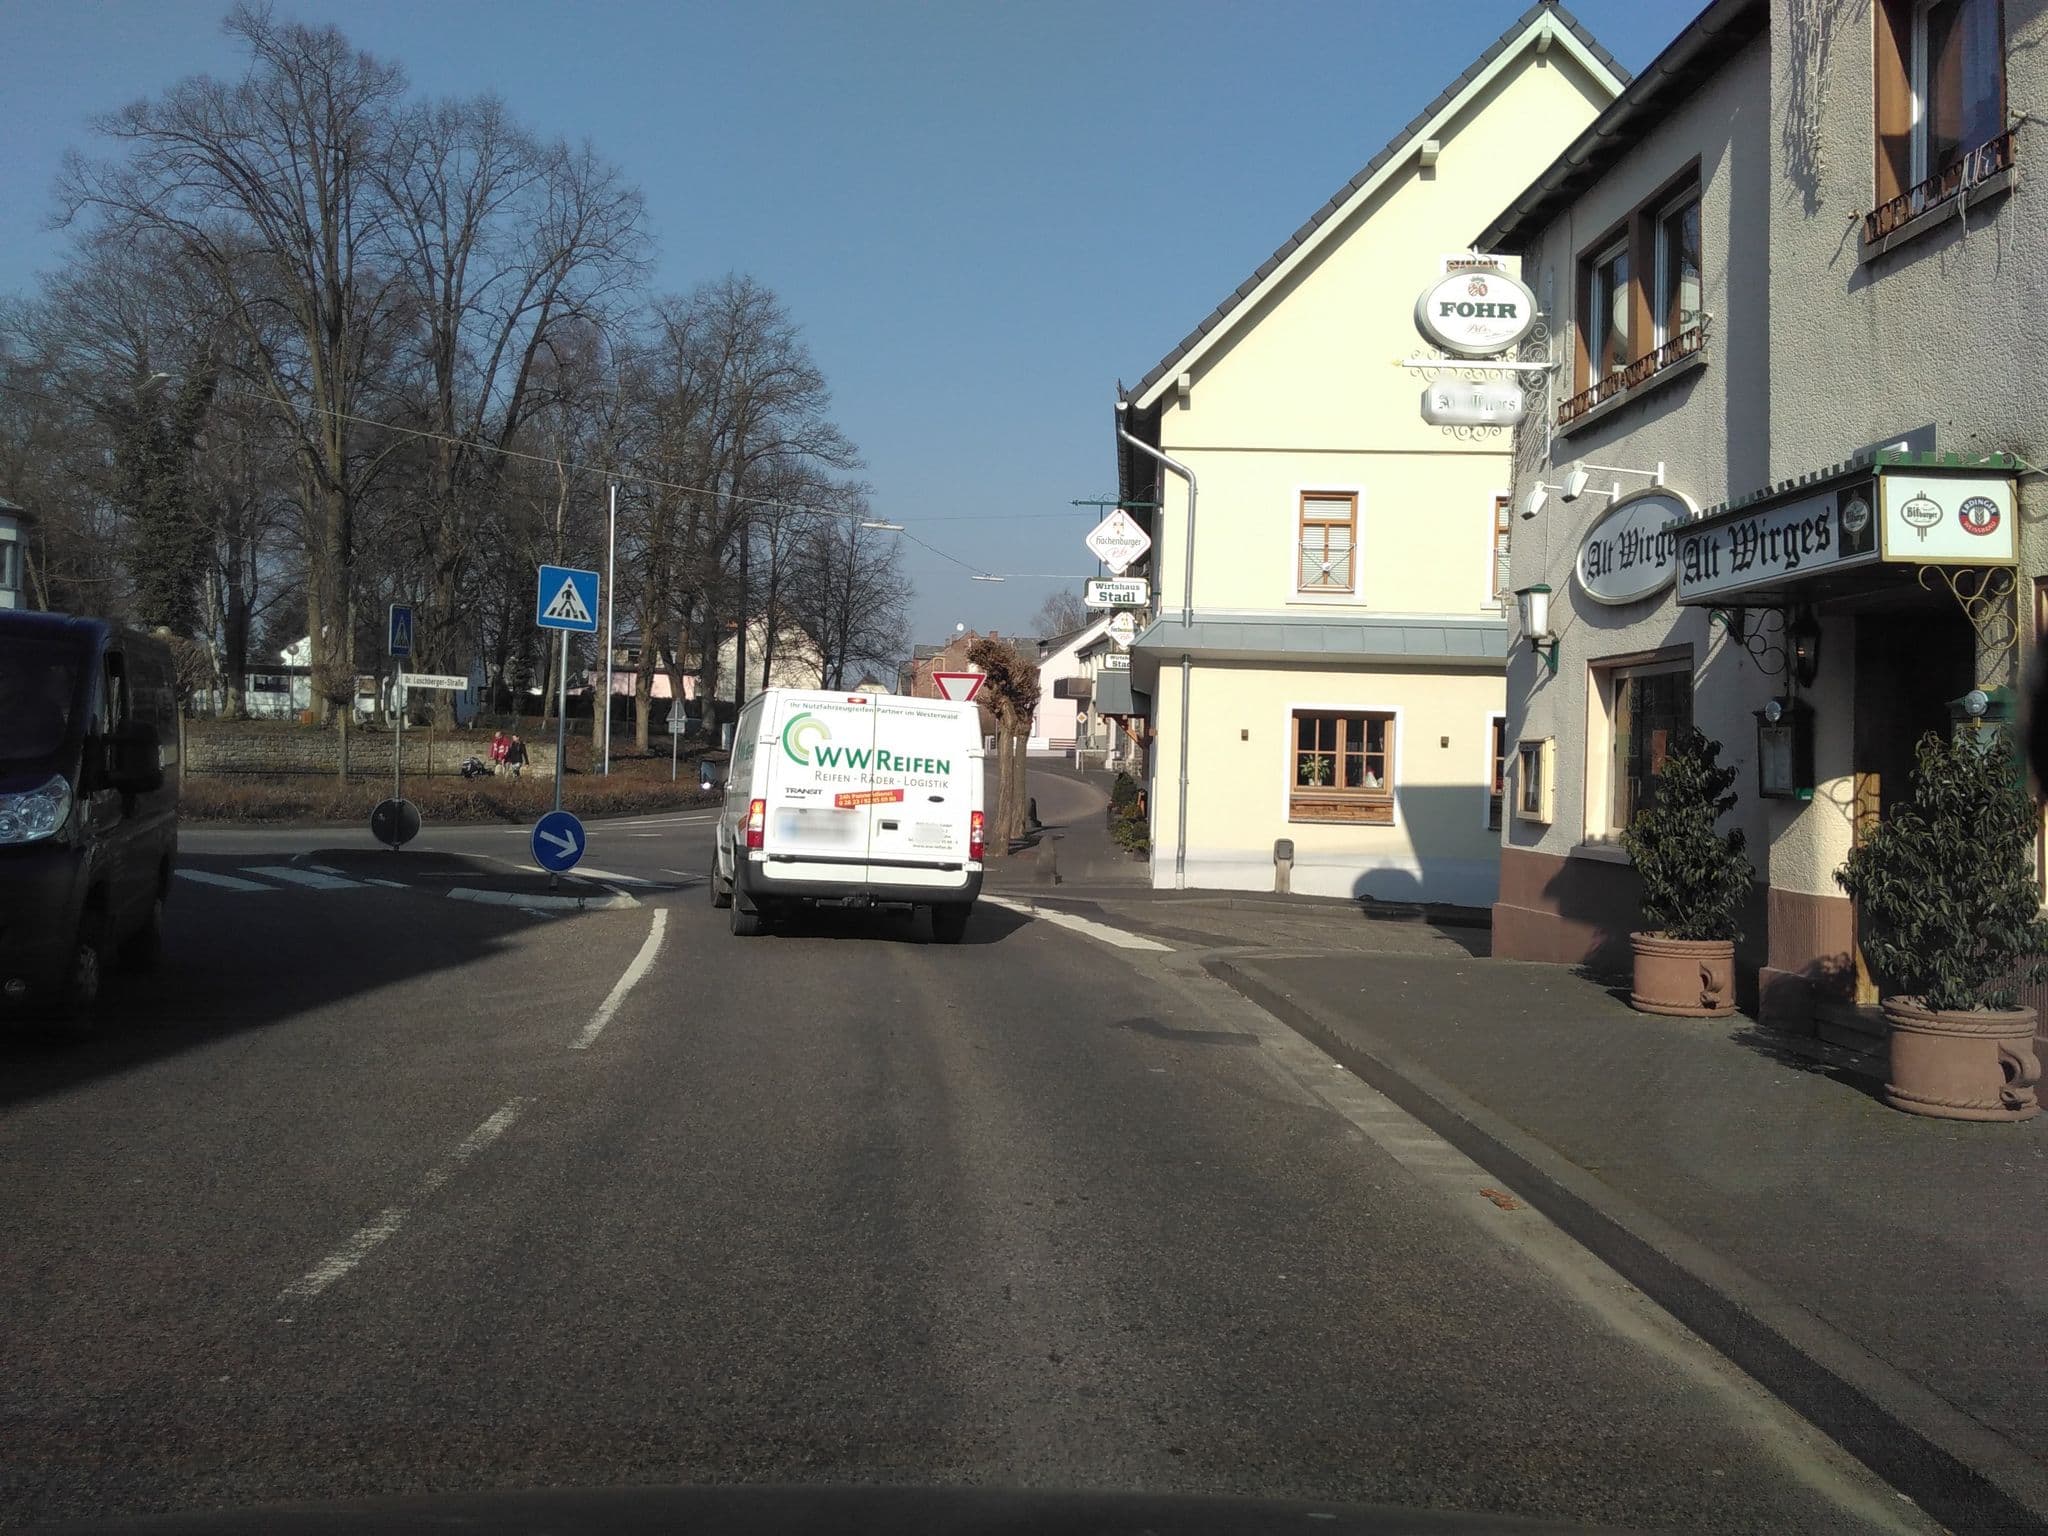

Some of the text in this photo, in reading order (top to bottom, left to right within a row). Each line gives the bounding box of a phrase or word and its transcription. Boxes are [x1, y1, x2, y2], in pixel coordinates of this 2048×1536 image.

[1439, 301, 1517, 319] FOHR
[1961, 497, 1997, 514] ERDINGER
[1096, 534, 1141, 549] Hachenburger
[1682, 506, 1830, 586] Alt Wirges
[1586, 526, 1676, 581] Alt Wirge
[1095, 582, 1140, 591] Wirtshaus
[1099, 592, 1136, 603] Stadl
[790, 702, 800, 710] Ihr
[877, 707, 903, 715] Partner
[916, 711, 958, 720] Westerwald
[815, 770, 850, 783] REIFEN
[904, 776, 949, 789] LOGISTIK
[785, 787, 823, 795] TRANSIT
